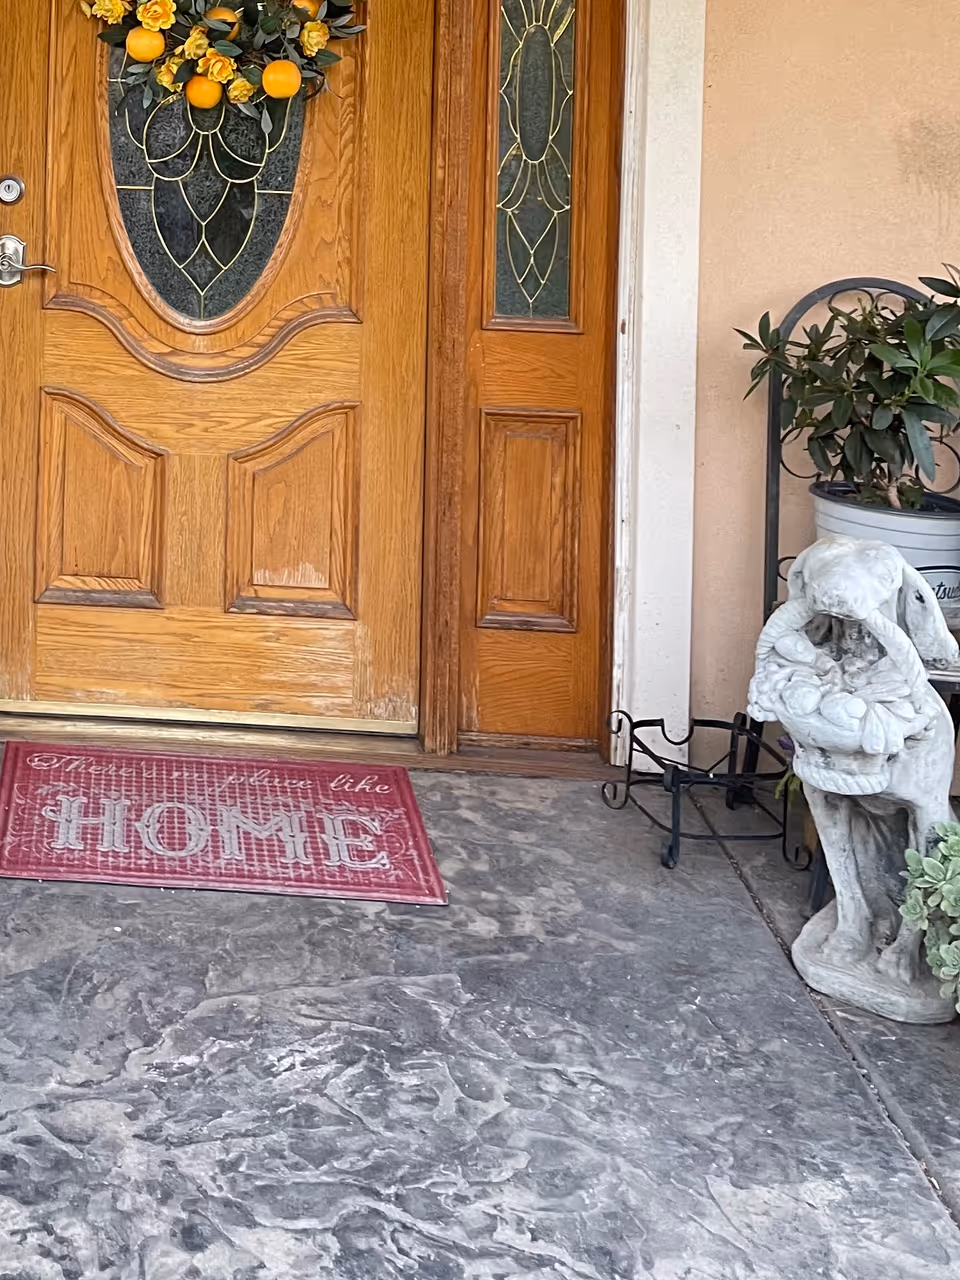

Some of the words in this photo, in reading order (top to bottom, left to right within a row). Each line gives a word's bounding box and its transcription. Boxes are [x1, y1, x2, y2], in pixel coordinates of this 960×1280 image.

[26, 753, 155, 779] There's
[208, 769, 315, 793] place
[329, 773, 393, 795] like
[41, 794, 392, 870] HOME
